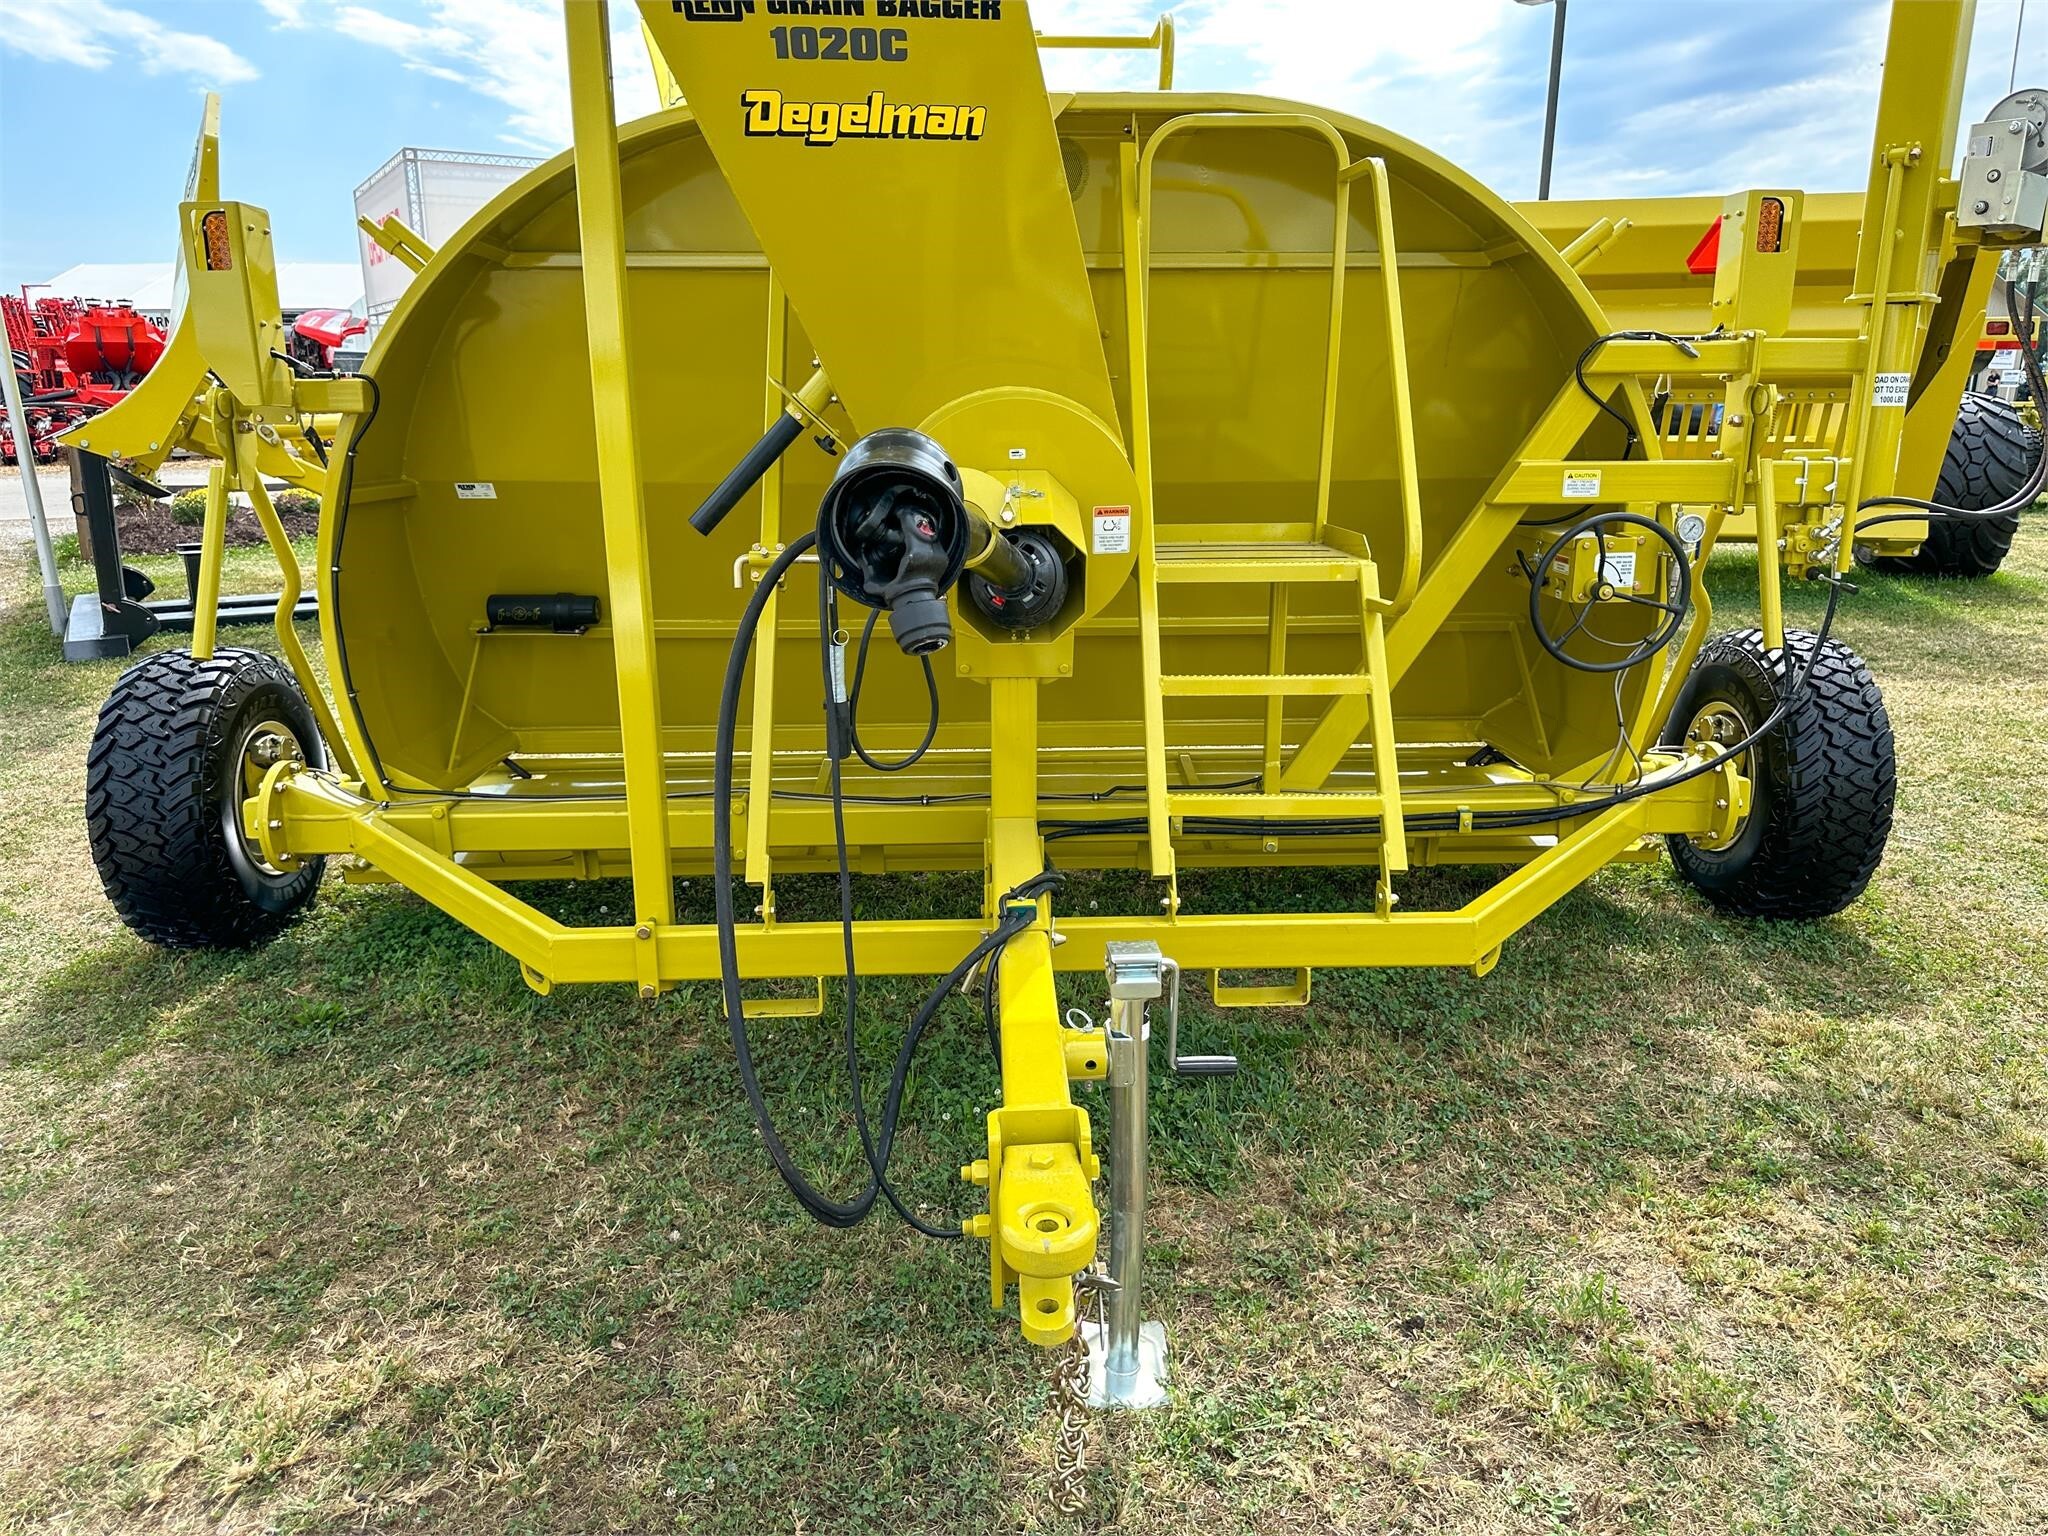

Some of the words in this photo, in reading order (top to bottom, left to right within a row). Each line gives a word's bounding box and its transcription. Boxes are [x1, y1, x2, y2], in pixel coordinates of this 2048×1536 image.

[768, 0, 864, 15] GRAIN
[877, 0, 1000, 20] BAGGER
[770, 26, 908, 62] 1020C
[741, 89, 987, 147] Degelman
[1874, 376, 1889, 384] OAD
